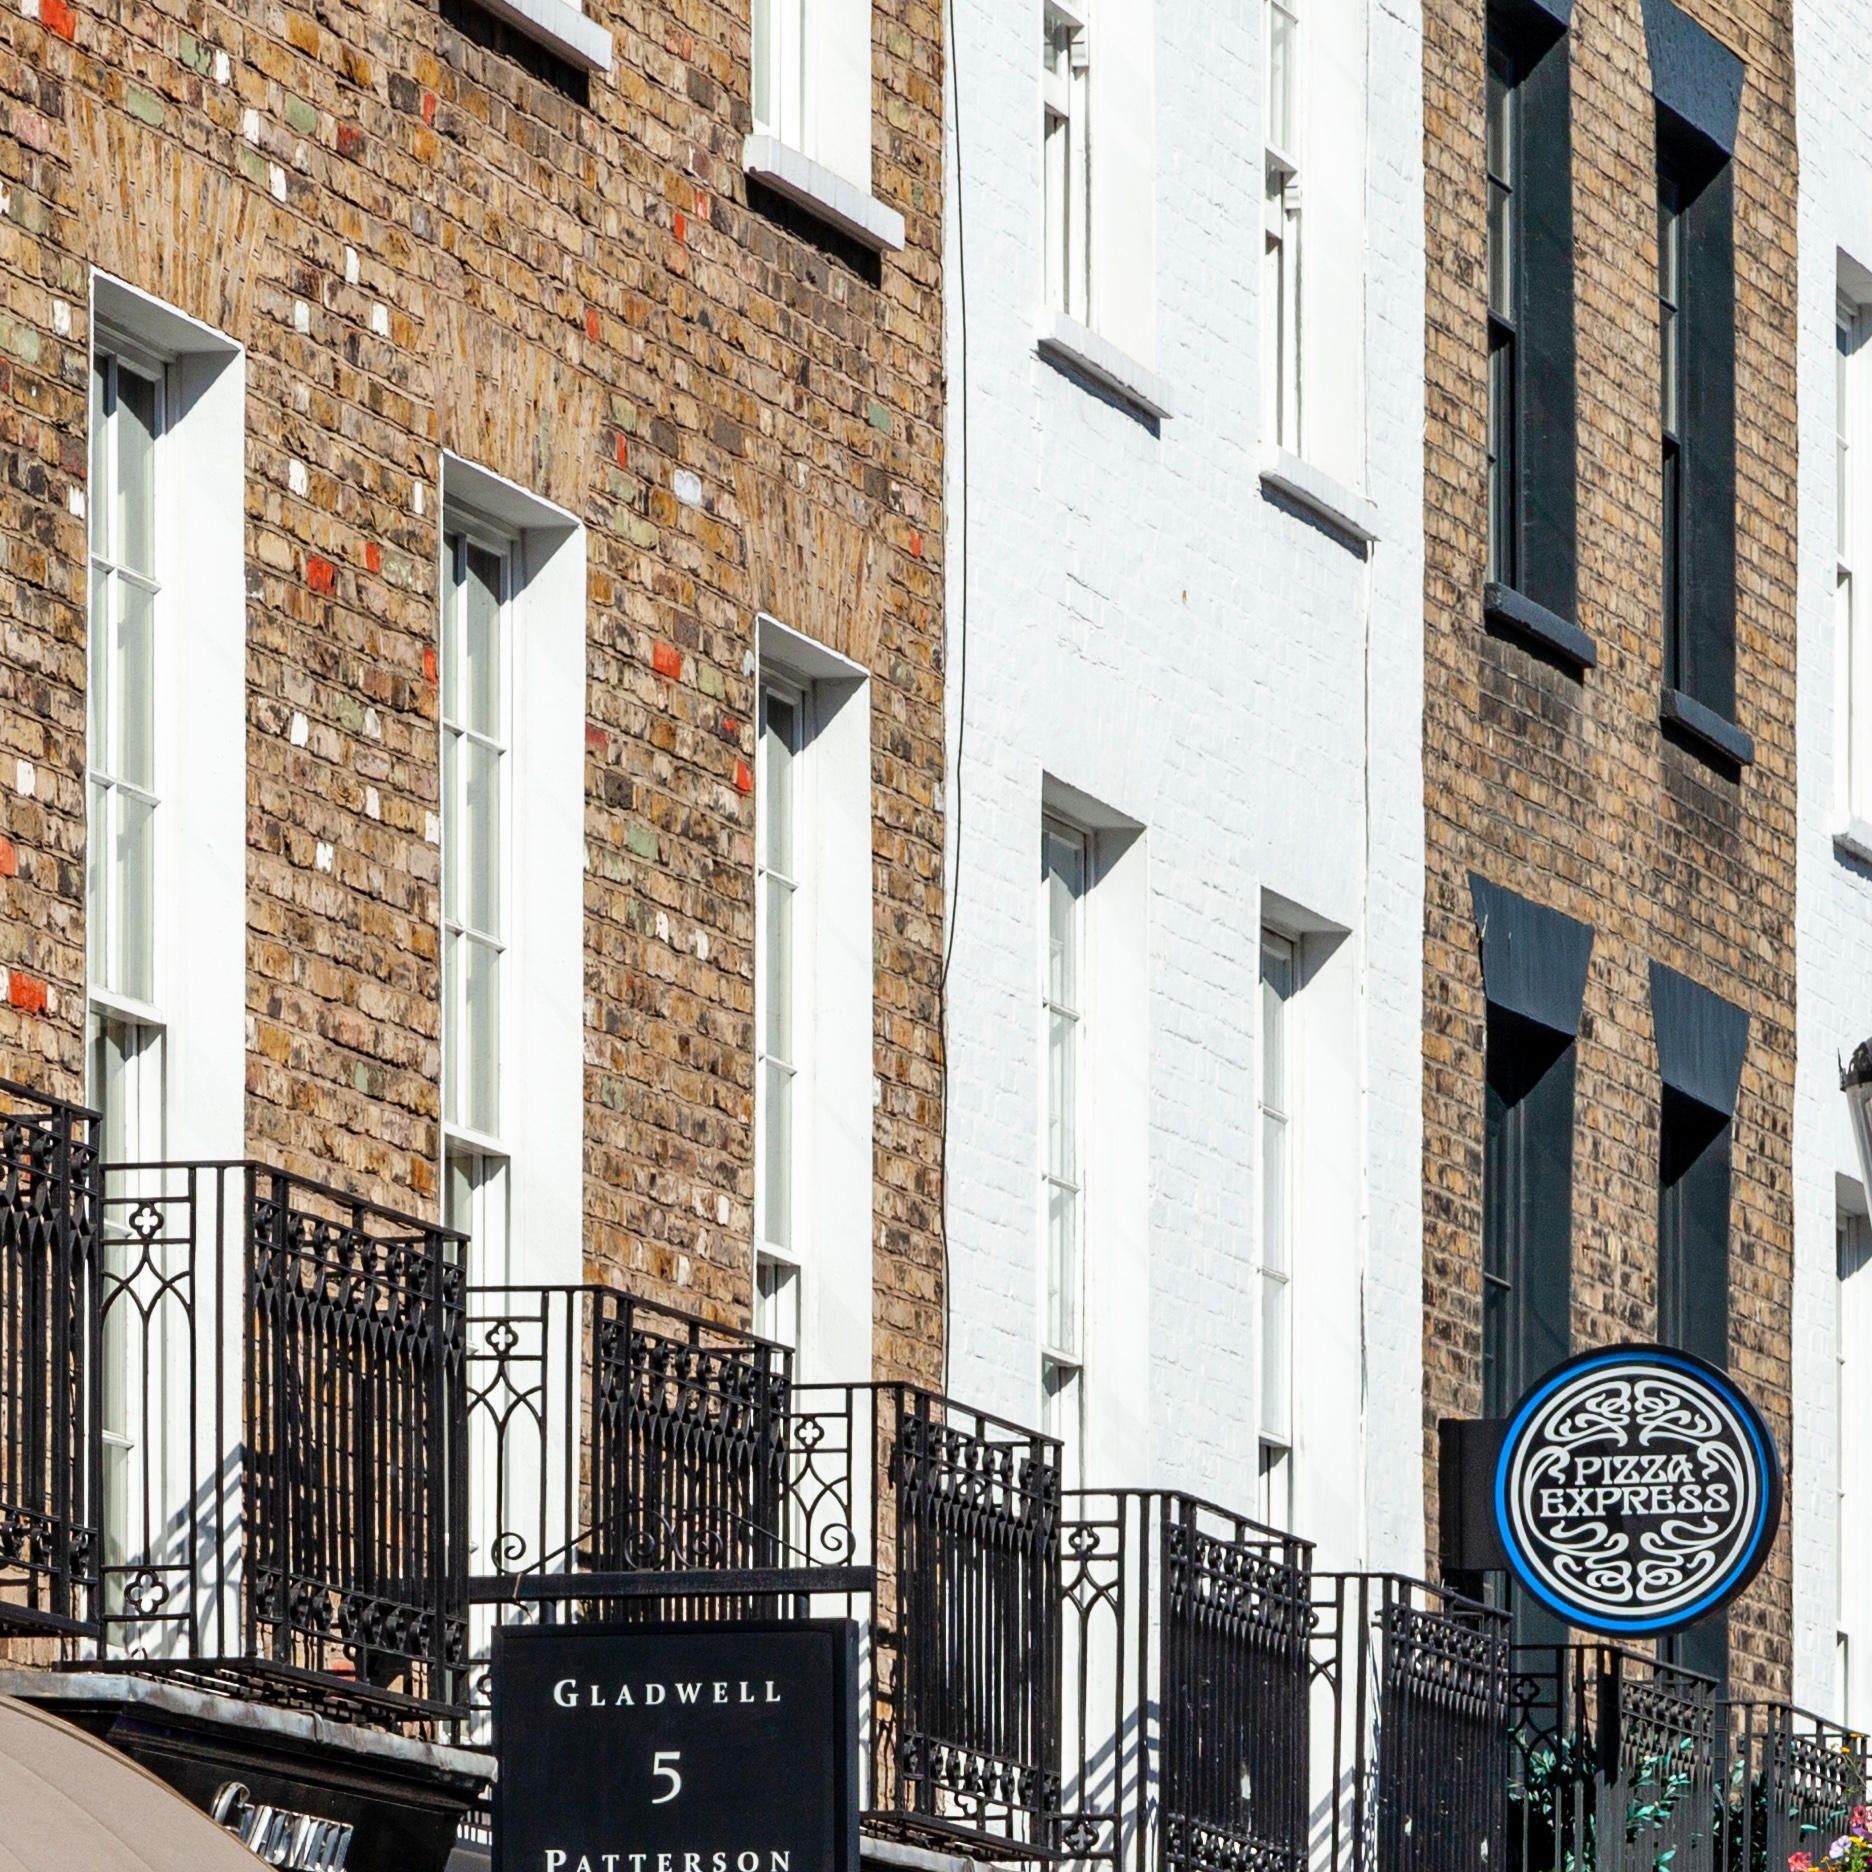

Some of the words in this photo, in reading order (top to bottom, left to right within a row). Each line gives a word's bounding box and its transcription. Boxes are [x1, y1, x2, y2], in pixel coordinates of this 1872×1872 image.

[1574, 1455, 1695, 1486] PIZZA
[1540, 1483, 1729, 1517] EXPRESS
[553, 1678, 784, 1708] GLADWELL
[652, 1750, 683, 1805] 5
